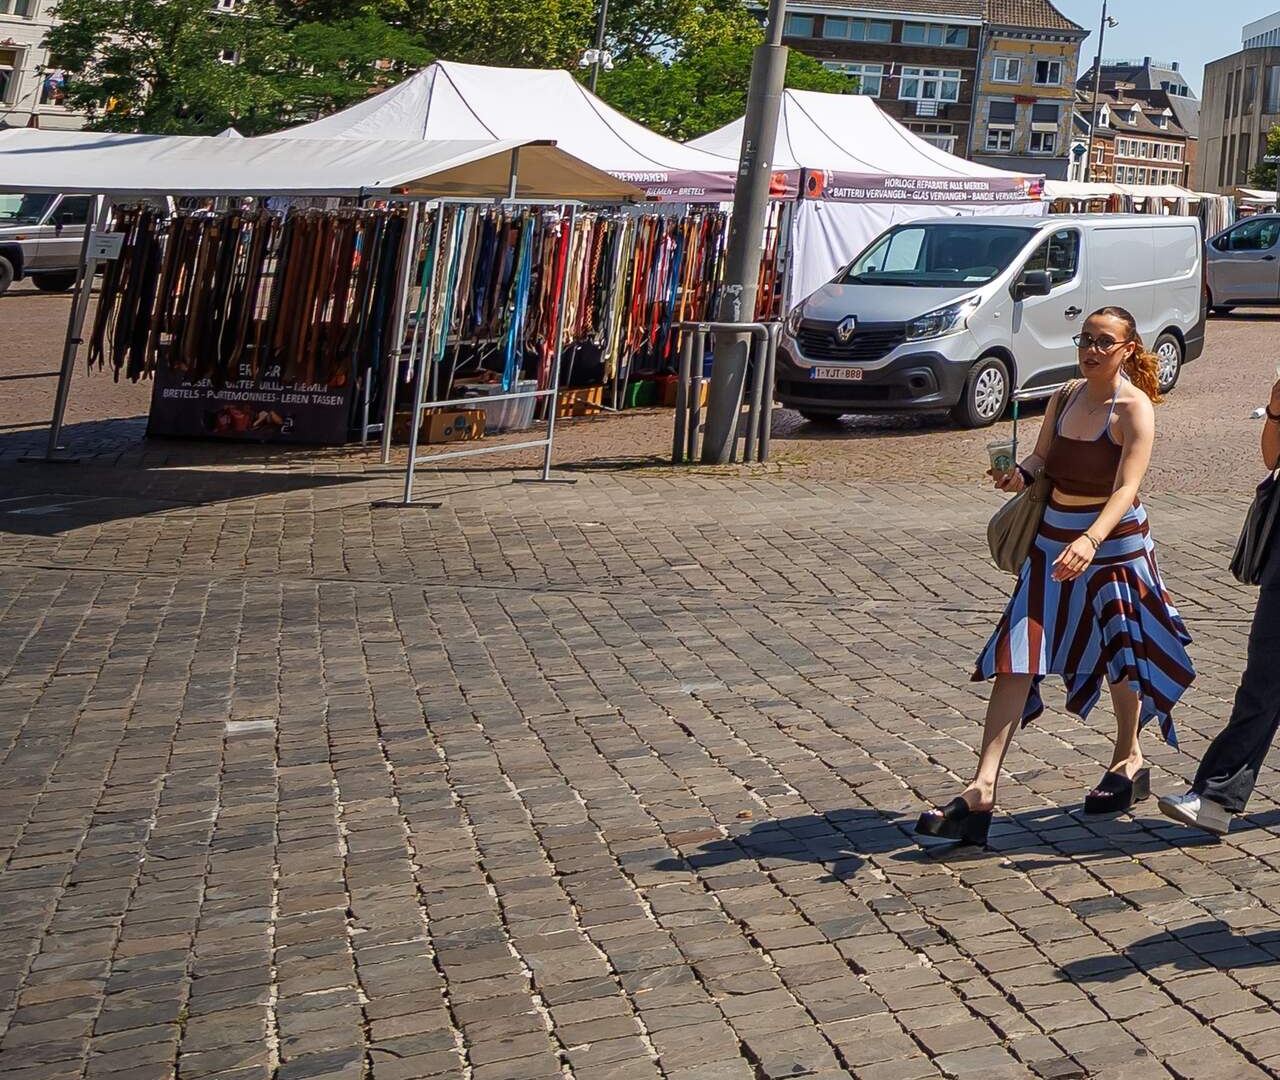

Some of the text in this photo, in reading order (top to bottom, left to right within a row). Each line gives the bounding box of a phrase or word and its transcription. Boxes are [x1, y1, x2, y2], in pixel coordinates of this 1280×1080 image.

[609, 172, 668, 183] DERWAREN
[885, 178, 990, 191] HORLOGE REPARATIE ALLE MERKEN
[678, 187, 705, 196] BRETELS
[866, 189, 906, 200] VERVANGEN
[912, 191, 930, 200] GLAS
[930, 191, 967, 201] VERVANGEN
[817, 368, 861, 378] 1-YJT-888
[163, 388, 200, 399] BRETELS
[206, 390, 276, 402] PORTEMONNEES
[281, 393, 309, 404] LEREN
[312, 394, 344, 405] TASSEN
